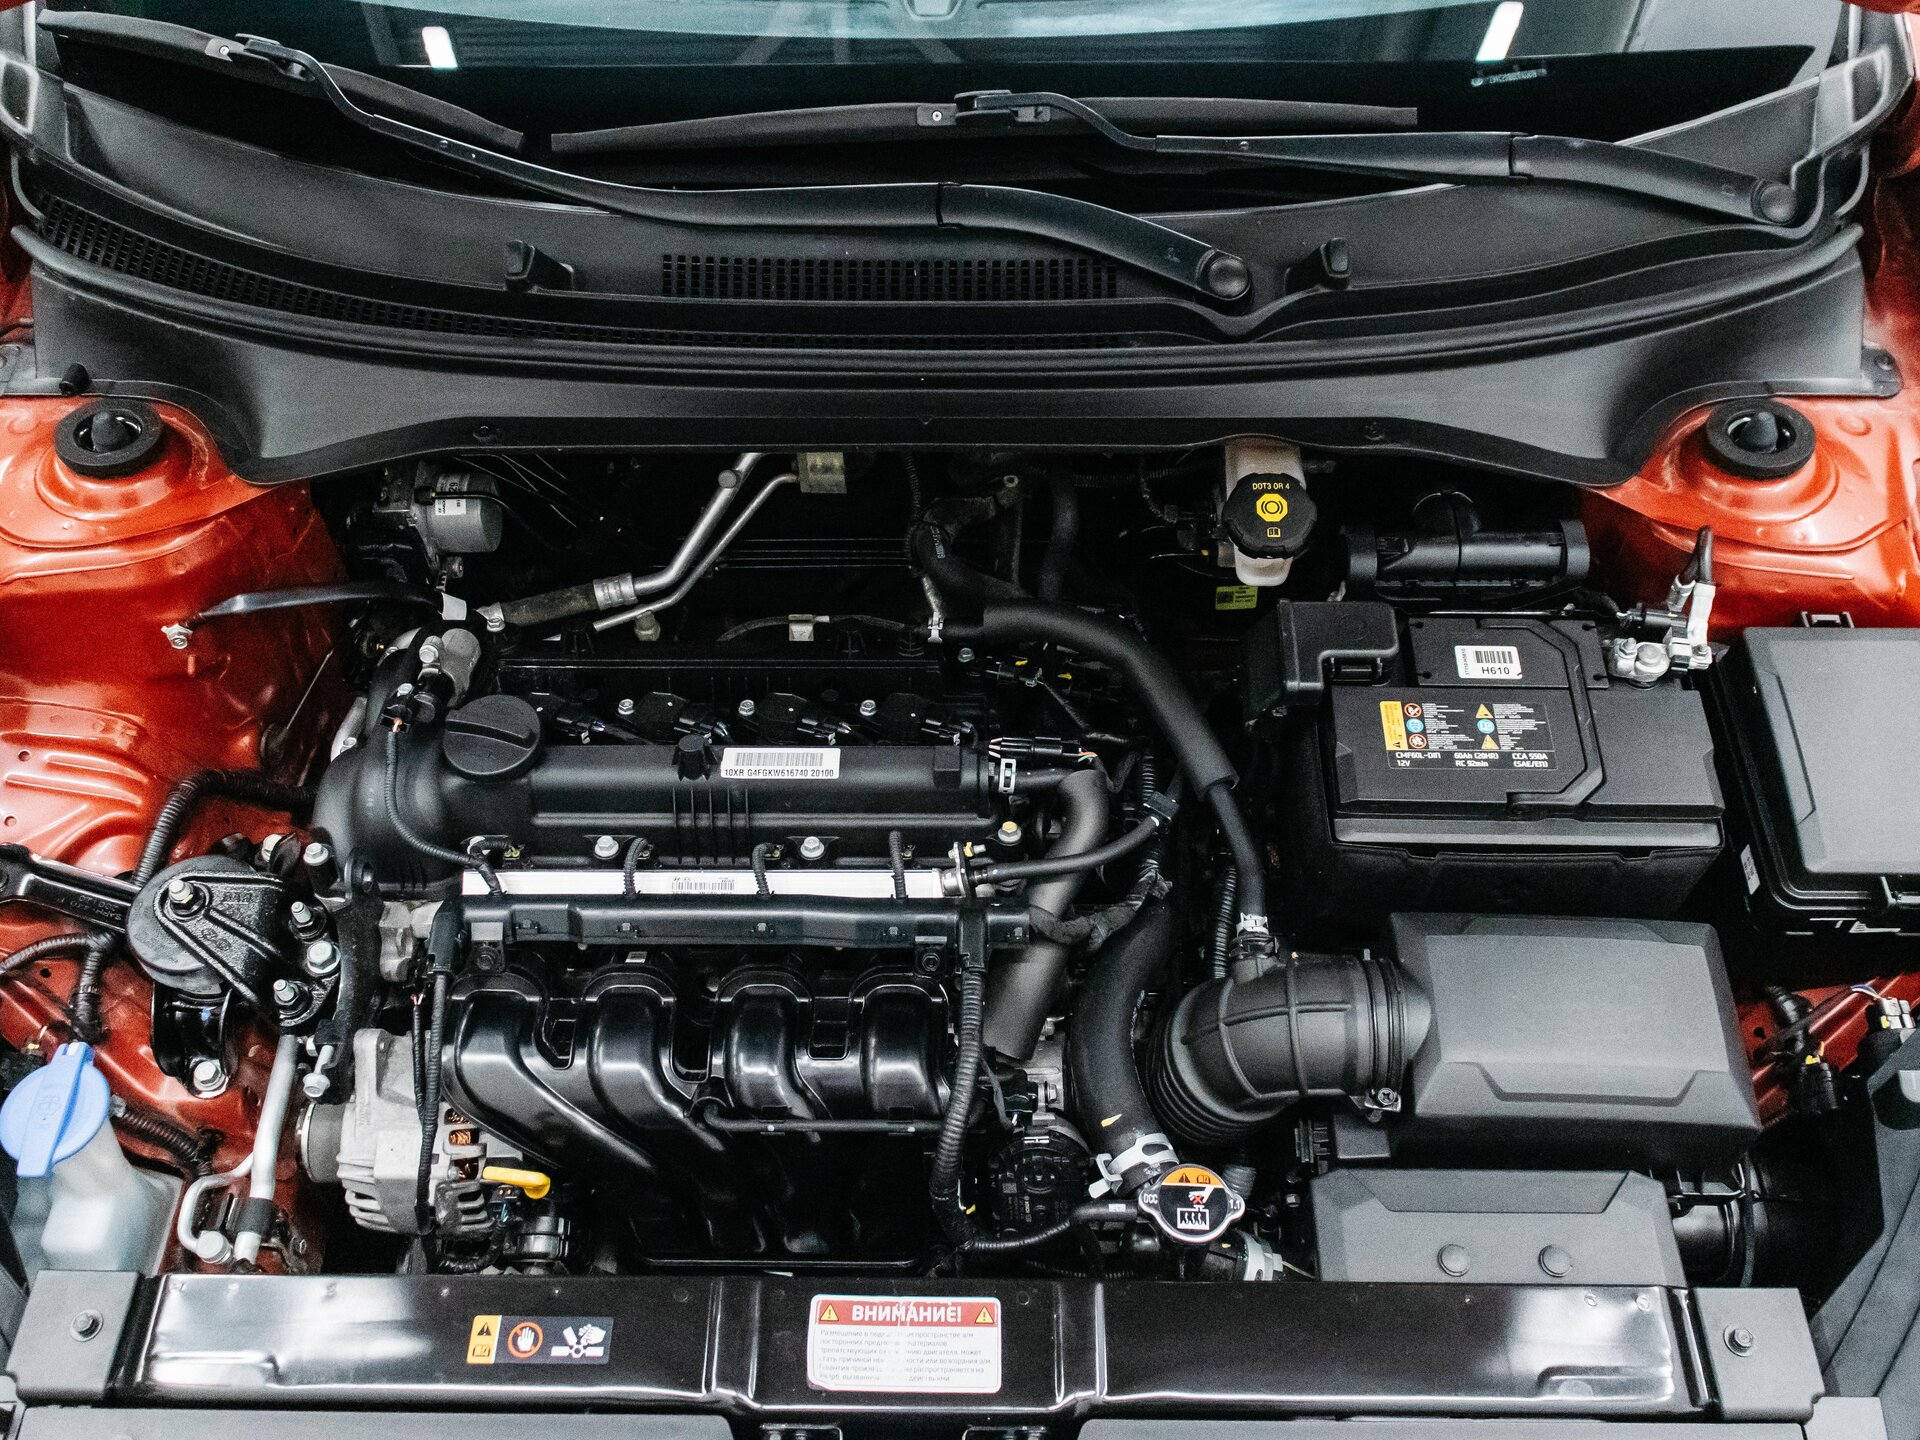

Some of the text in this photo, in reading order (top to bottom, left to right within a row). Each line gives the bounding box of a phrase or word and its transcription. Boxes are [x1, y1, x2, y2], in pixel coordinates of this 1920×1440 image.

[1252, 482, 1290, 490] DOT3 OR 4
[1481, 666, 1510, 675] H610
[1454, 752, 1473, 760] 60Ah
[1511, 752, 1528, 760] CCA
[724, 769, 834, 777] 10XR G4FGKW616740 20100
[1143, 1193, 1158, 1205] DCC
[1229, 1199, 1241, 1210] 1.1
[852, 1304, 962, 1323] ВНИМАНИЕ!
